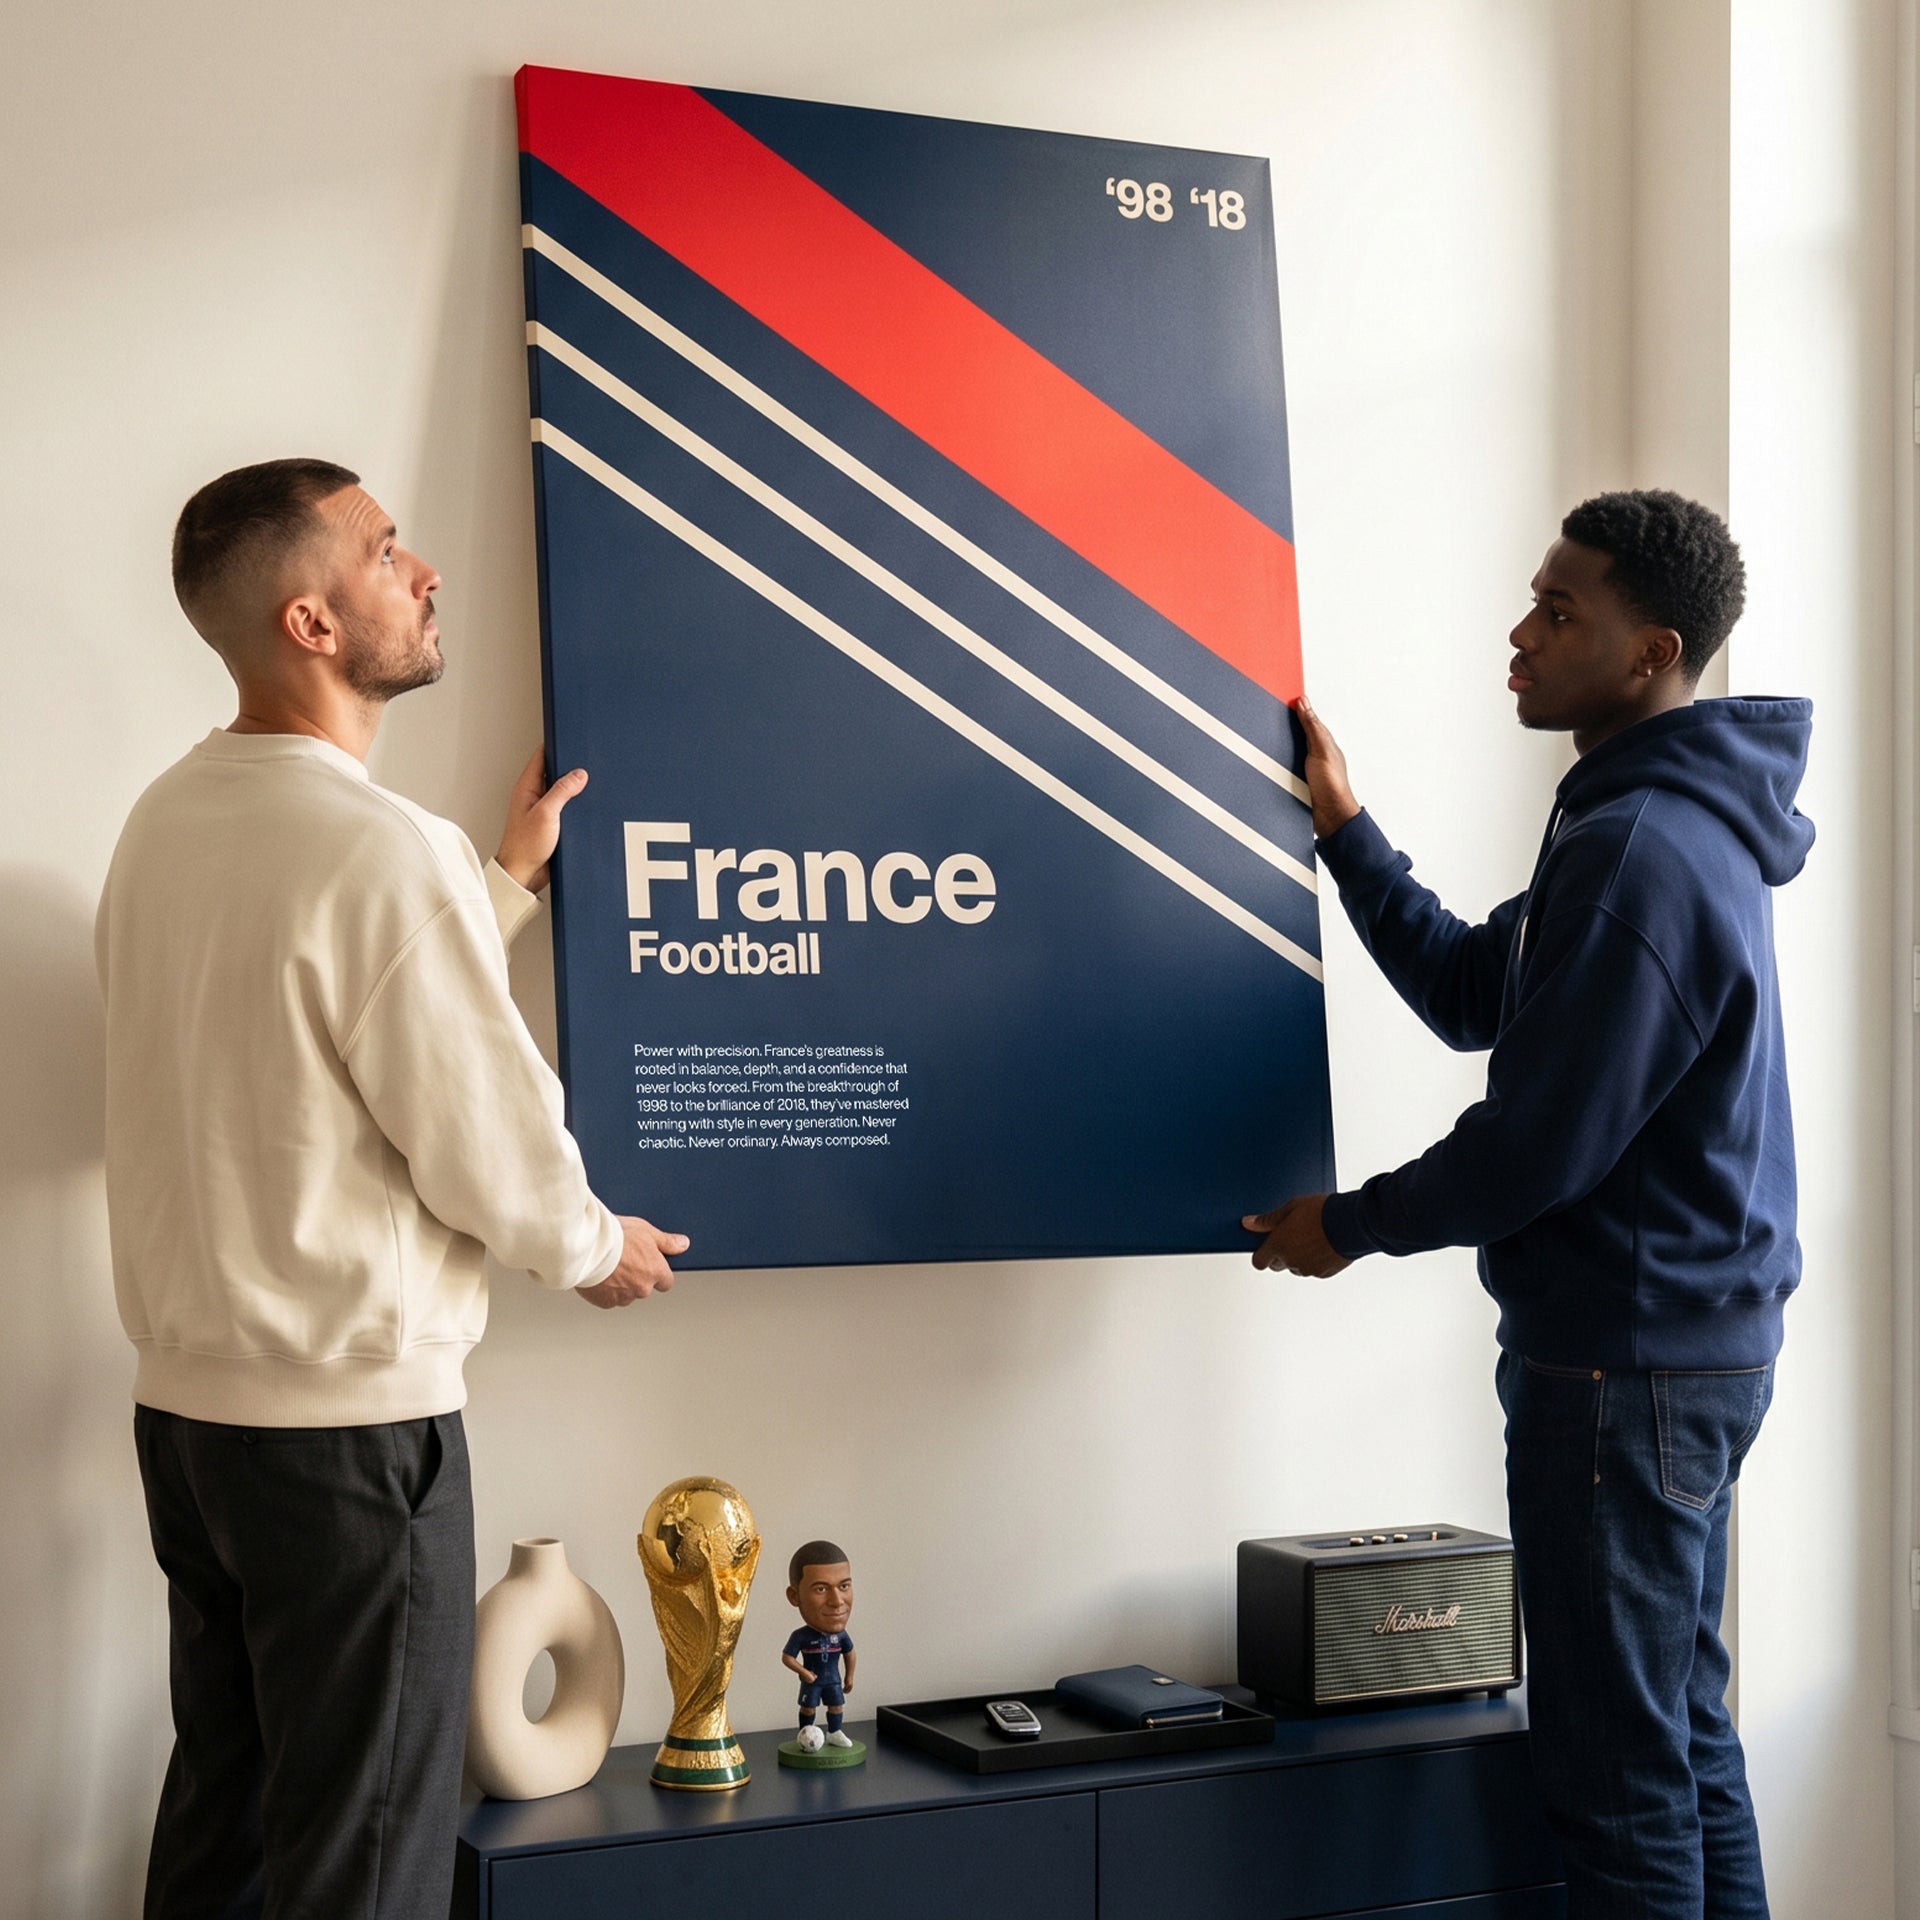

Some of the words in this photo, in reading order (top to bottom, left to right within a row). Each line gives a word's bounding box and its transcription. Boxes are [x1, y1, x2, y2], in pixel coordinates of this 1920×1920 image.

[623, 821, 996, 924] France
[629, 931, 820, 975] Football
[634, 1044, 674, 1056] Power
[676, 1044, 703, 1056] with
[705, 1045, 762, 1059] precision.
[764, 1044, 813, 1056] France's
[815, 1046, 873, 1060] greatness
[875, 1045, 885, 1056] is
[635, 1063, 676, 1075] rooted
[678, 1063, 689, 1075] in
[691, 1063, 742, 1077] balance,
[743, 1062, 781, 1077] depth,
[783, 1062, 806, 1075] and
[808, 1065, 816, 1074] a
[818, 1062, 883, 1074] confidence
[885, 1062, 908, 1074] that
[636, 1083, 671, 1094] never
[708, 1081, 750, 1093] forced.
[752, 1081, 784, 1093] From
[786, 1081, 805, 1092] the
[807, 1080, 885, 1095] breakthrough
[887, 1080, 899, 1092] of
[637, 1099, 668, 1112] 1998
[670, 1100, 683, 1112] to
[685, 1100, 705, 1111] the
[706, 1099, 761, 1111] brilliance
[763, 1098, 775, 1111] of
[777, 1098, 809, 1111] 2018,
[854, 1097, 909, 1110] mastered
[637, 1118, 687, 1133] winning
[688, 1118, 714, 1129] with
[717, 1117, 745, 1132] style
[747, 1117, 757, 1129] in
[760, 1119, 793, 1131] every
[795, 1116, 860, 1131] generation.
[862, 1116, 897, 1128] Never
[638, 1137, 687, 1149] chaotic.
[689, 1136, 725, 1148] Never
[727, 1136, 778, 1149] ordinary.
[781, 1134, 823, 1149] Always
[825, 1133, 891, 1148] composed.
